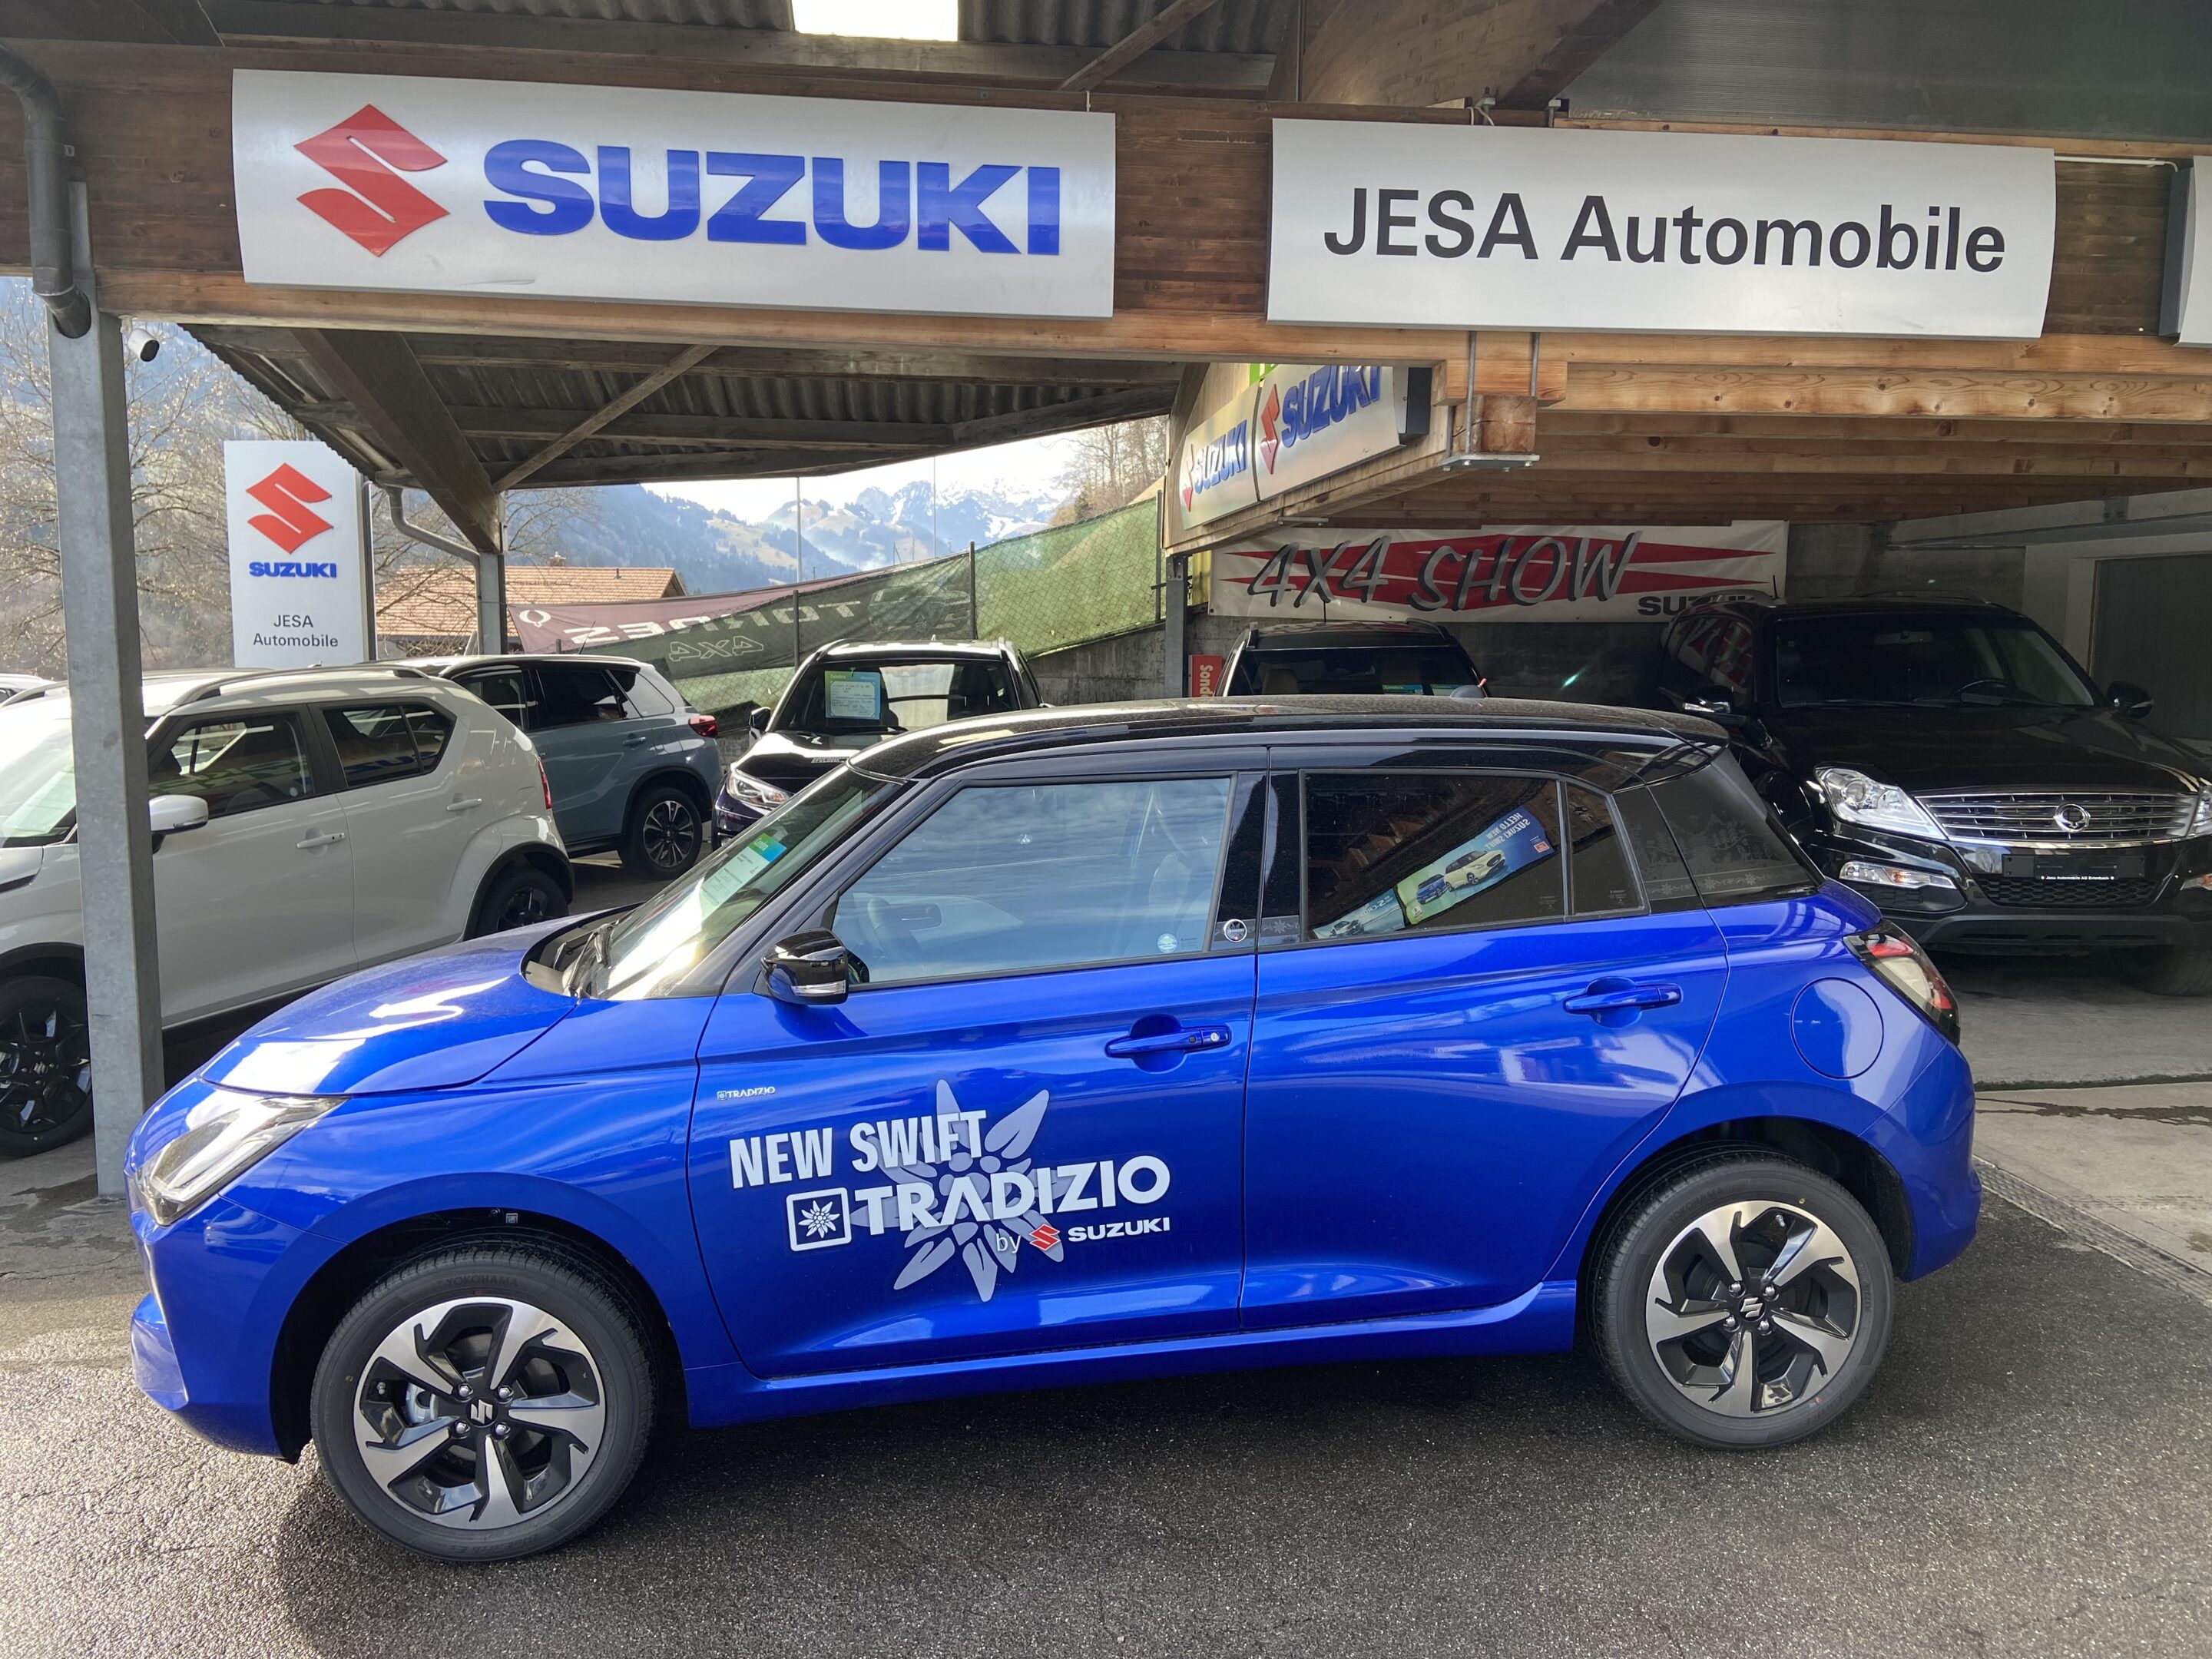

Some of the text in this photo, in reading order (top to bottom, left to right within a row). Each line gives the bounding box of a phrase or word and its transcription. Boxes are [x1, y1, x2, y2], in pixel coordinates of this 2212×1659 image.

[483, 139, 1060, 256] SUZUKI
[1324, 187, 2005, 273] JESA Automobile
[1281, 365, 1380, 448] SUZUKI
[1194, 419, 1247, 494] SUZUKI
[249, 562, 336, 578] SUZUKI
[1406, 531, 1642, 611] SHOW
[253, 633, 339, 647] Automobile
[273, 614, 313, 628] JESA
[1200, 664, 1214, 697] Sond
[727, 1086, 776, 1098] TRADIZIO
[730, 1110, 987, 1189] NEW SWIFT
[854, 1155, 1171, 1235] TRADIZIO
[995, 1217, 1171, 1253] by SUZUKI
